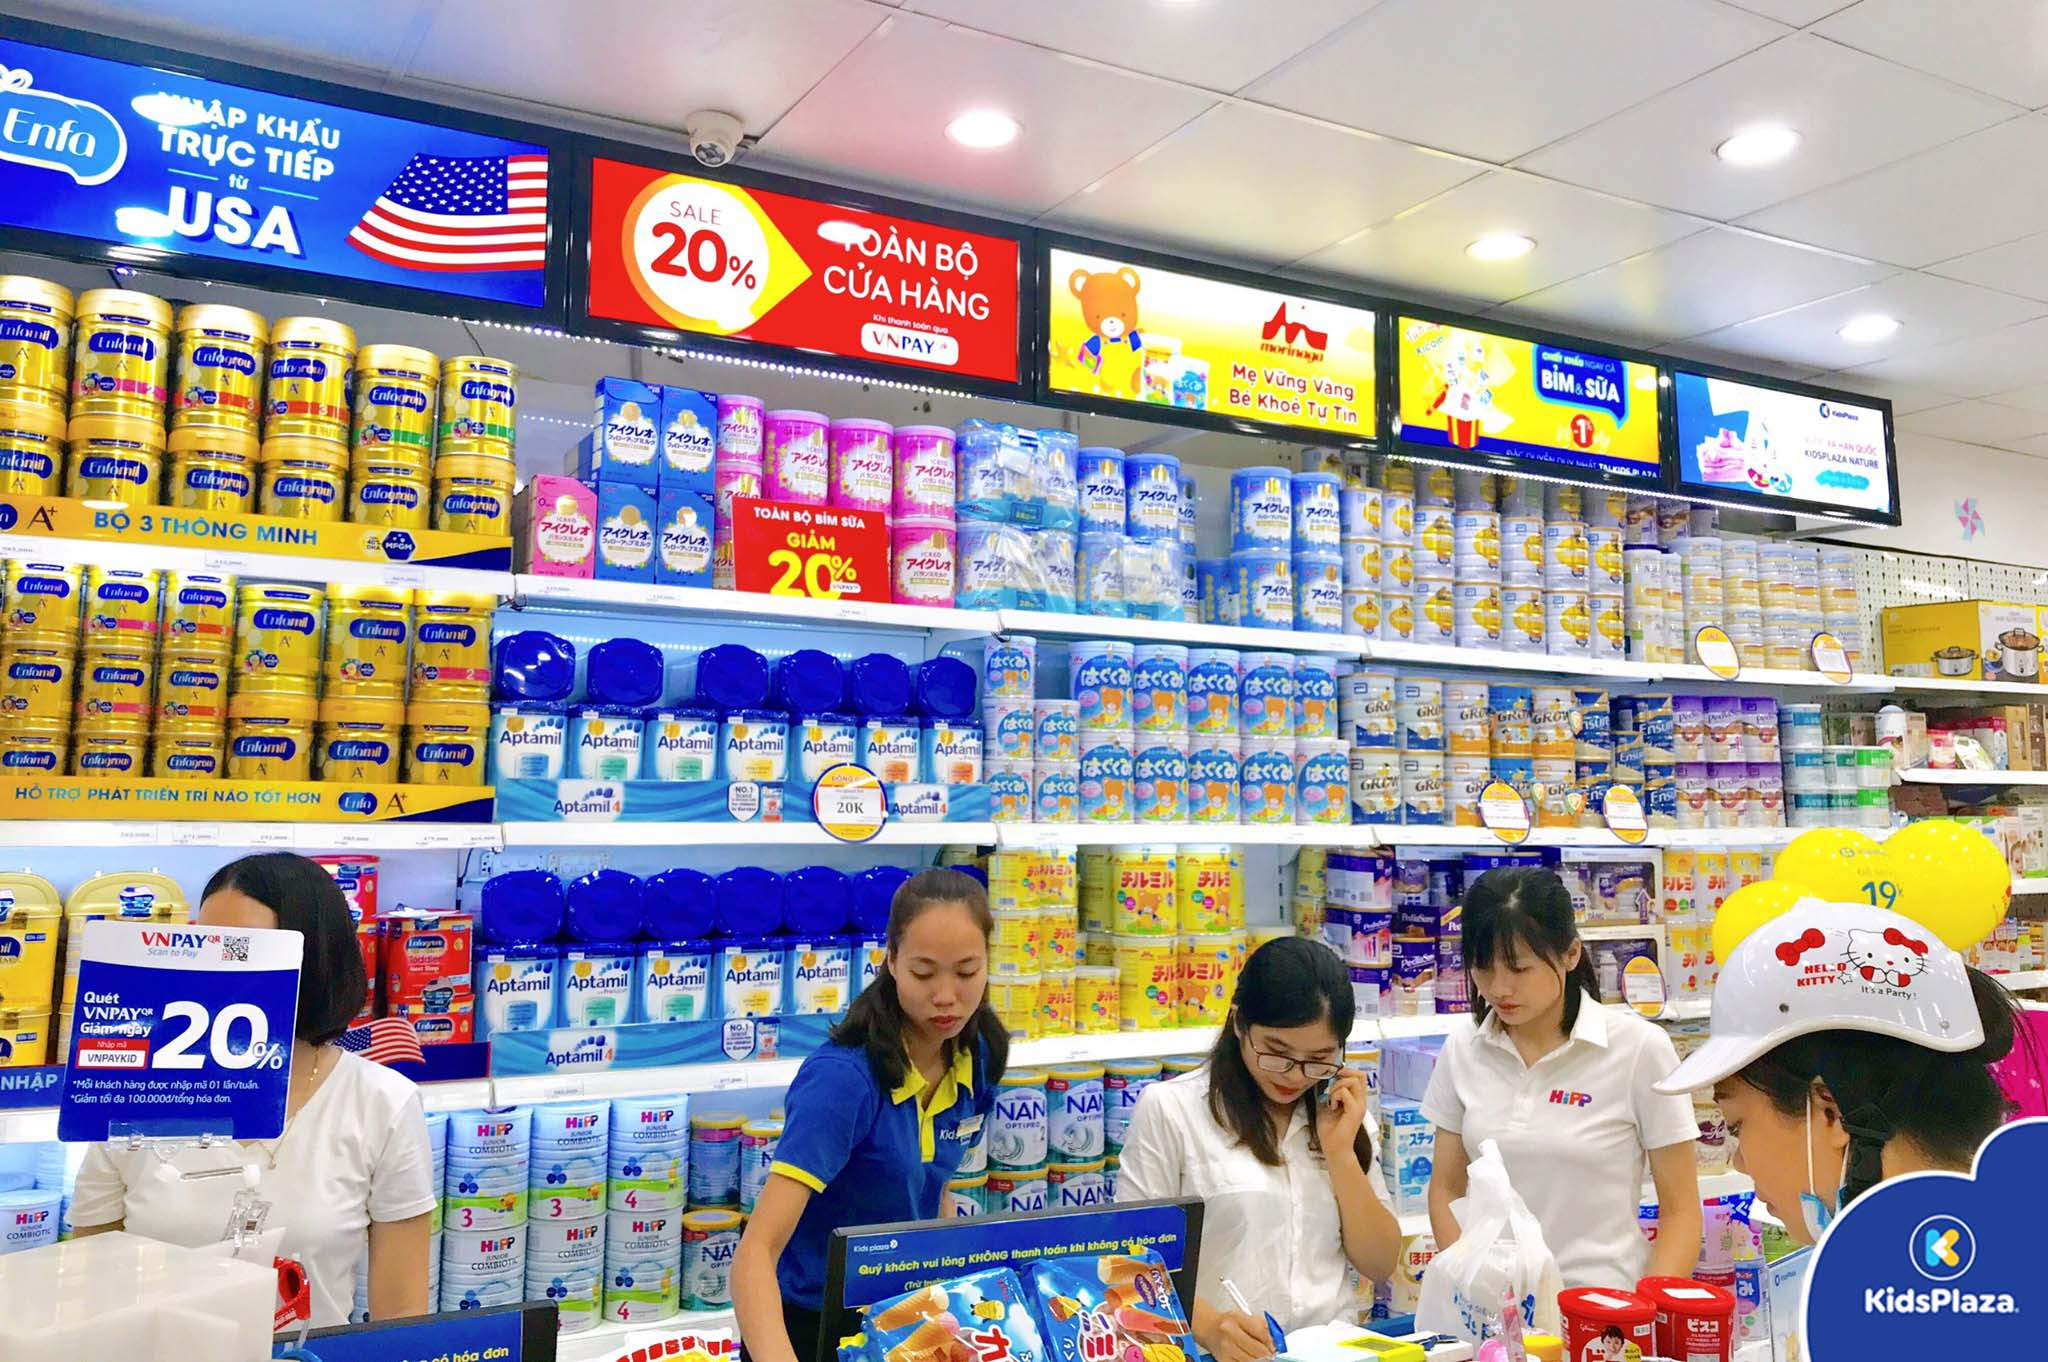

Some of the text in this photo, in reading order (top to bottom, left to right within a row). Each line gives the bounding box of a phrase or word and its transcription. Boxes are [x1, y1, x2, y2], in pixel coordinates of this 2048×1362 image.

[160, 95, 341, 151] ẬP KHẨU
[3, 108, 97, 158] Enfa
[158, 124, 335, 183] TRỰC TIẾP
[229, 171, 248, 191] từ
[166, 186, 303, 257] USA
[669, 200, 722, 226] SALE
[650, 221, 757, 291] 20%
[936, 242, 979, 282] BỘ
[822, 262, 991, 321] CỬA HÀNG
[1233, 363, 1257, 386] Mẹ
[1263, 369, 1307, 393] Vững
[1541, 364, 1621, 404] BỈM SỮA
[1307, 400, 1328, 423] Tự
[1333, 404, 1357, 424] Tin
[607, 422, 655, 440] アイクレオ
[753, 506, 790, 522] TOÀN
[793, 510, 812, 526] BỘ
[94, 510, 131, 534] BỘ
[140, 516, 153, 533] 3
[162, 513, 248, 541] THÔNG
[256, 525, 318, 546] MINH
[540, 521, 591, 537] アイクレオ
[663, 532, 707, 546] アイクレオ
[786, 529, 836, 551] GIẢM
[768, 549, 857, 600] 20%
[465, 669, 476, 681] 2
[1081, 666, 1132, 688] はぐくみ
[1245, 677, 1294, 696] はぐくみ
[500, 730, 562, 747] Aptamil
[657, 734, 714, 752] Aptamil
[933, 742, 982, 757] Aptamil
[1082, 757, 1133, 778] はぐくみ
[15, 783, 321, 804] HỖ TRỢ PHÁT TRIỂN TRÍ NÃO TỐT HƠN
[553, 799, 622, 816] Aptamil 4
[836, 801, 864, 814] 20K
[892, 801, 940, 818] Aptamil
[1120, 871, 1174, 889] チルミル
[141, 931, 208, 948] VNPAY
[147, 948, 199, 959] Scan to Pay
[725, 967, 780, 985] Aptamil
[1796, 974, 1836, 988] KITTY
[487, 977, 550, 995] Aptamil
[1861, 985, 1875, 994] It's
[84, 991, 119, 1006] Quét
[84, 1007, 142, 1020] VNPAY
[80, 1021, 151, 1038] Giảm ngày
[152, 1000, 283, 1070] 20%
[87, 1052, 138, 1064] VNPAYKID
[545, 1048, 614, 1066] Aptamil 4
[94, 1080, 122, 1089] khách
[123, 1080, 147, 1091] hàng
[147, 1080, 169, 1090] được
[170, 1080, 193, 1091] nhập
[194, 1080, 207, 1089] mã
[208, 1080, 221, 1089] 01
[99, 1092, 112, 1104] tối
[113, 1094, 125, 1104] đa
[196, 1094, 213, 1104] hóa
[1549, 1089, 1593, 1108] HiPP
[640, 1109, 675, 1124] HiPP
[995, 1100, 1046, 1121] NAN
[477, 1123, 515, 1137] HiPP
[624, 1190, 638, 1209] 4
[15, 1210, 49, 1226] HiPP
[461, 1208, 473, 1228] 3
[566, 1225, 598, 1241] HiPP
[853, 1244, 869, 1253] Kids
[858, 1264, 882, 1276] Quý
[885, 1259, 921, 1274] khách
[922, 1258, 939, 1269] vui
[941, 1256, 966, 1270] lòng
[968, 1248, 1009, 1265] KHÔNG
[1011, 1246, 1041, 1260] thanh
[1043, 1244, 1068, 1257] toán
[1070, 1242, 1086, 1255] khi
[1087, 1239, 1120, 1257] không
[1156, 1233, 1177, 1245] đơn
[1686, 1318, 1720, 1334] ビスコ
[453, 1350, 480, 1362] hóa
[482, 1347, 510, 1359] đơn
